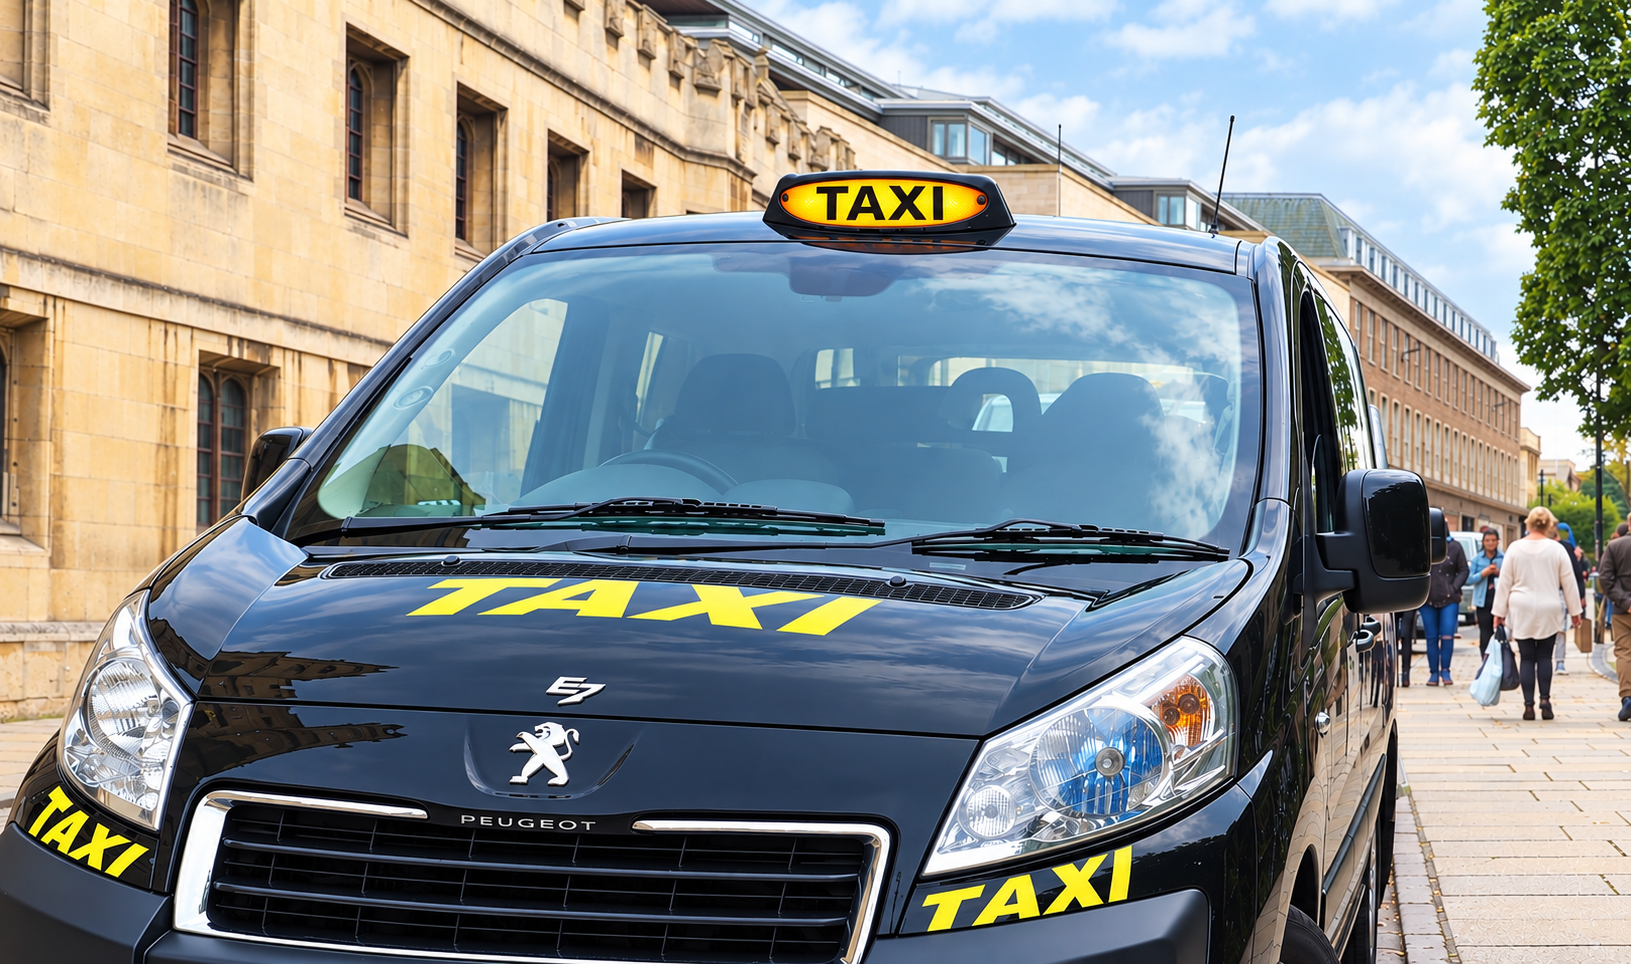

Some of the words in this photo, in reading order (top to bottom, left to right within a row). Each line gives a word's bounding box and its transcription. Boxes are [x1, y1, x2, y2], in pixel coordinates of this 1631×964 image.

[816, 185, 944, 221] TAXI
[407, 578, 881, 636] TAXI
[546, 676, 606, 706] E7
[27, 785, 150, 878] TAXI
[460, 814, 597, 831] PEUGEOT
[922, 846, 1132, 932] TAXI
